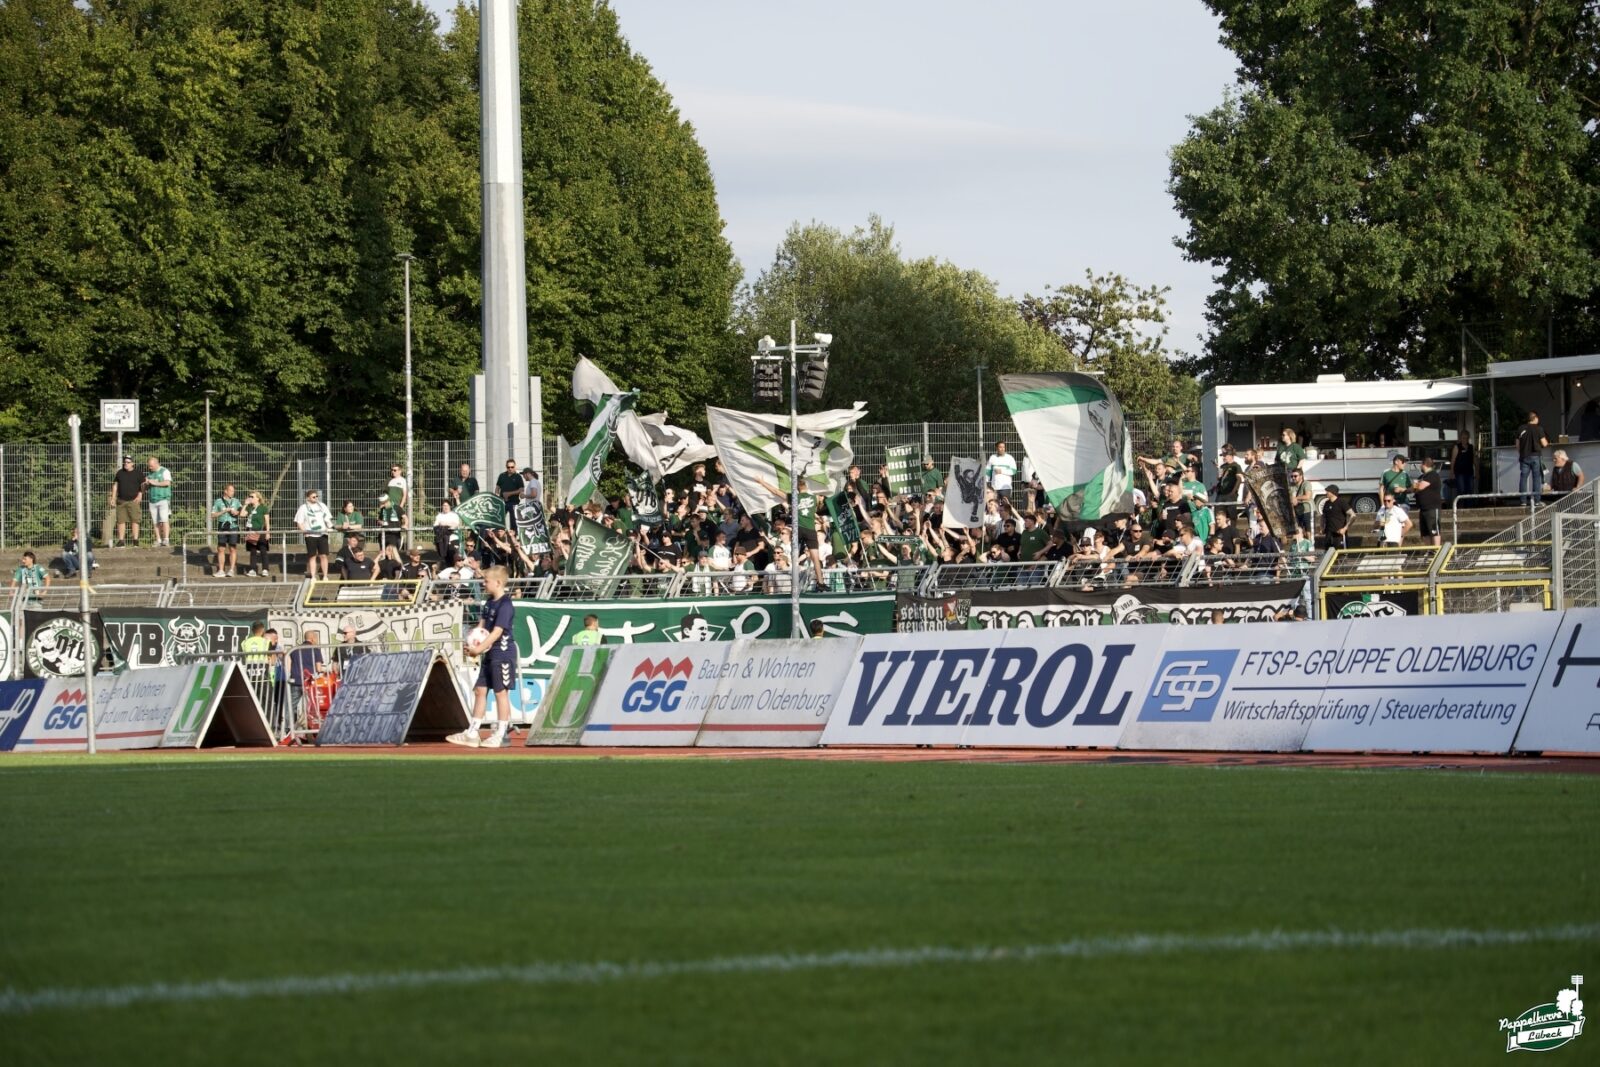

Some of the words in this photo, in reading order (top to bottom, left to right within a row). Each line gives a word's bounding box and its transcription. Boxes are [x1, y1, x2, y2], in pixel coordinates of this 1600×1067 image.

[698, 659, 737, 679] Bauen
[741, 657, 752, 678] &
[757, 656, 816, 678] Wohnen
[1240, 648, 1395, 676] FTSP-GRUPPE
[1396, 643, 1537, 673] OLDENBURG
[622, 680, 687, 713] GSG
[848, 643, 1136, 728] VIEROL
[685, 691, 697, 710] in
[701, 689, 729, 710] und
[731, 694, 751, 710] um
[757, 688, 832, 716] Oldenburg
[1223, 698, 1370, 725] Wirtschaftsprüfung
[1381, 698, 1516, 725] Steuerberatung
